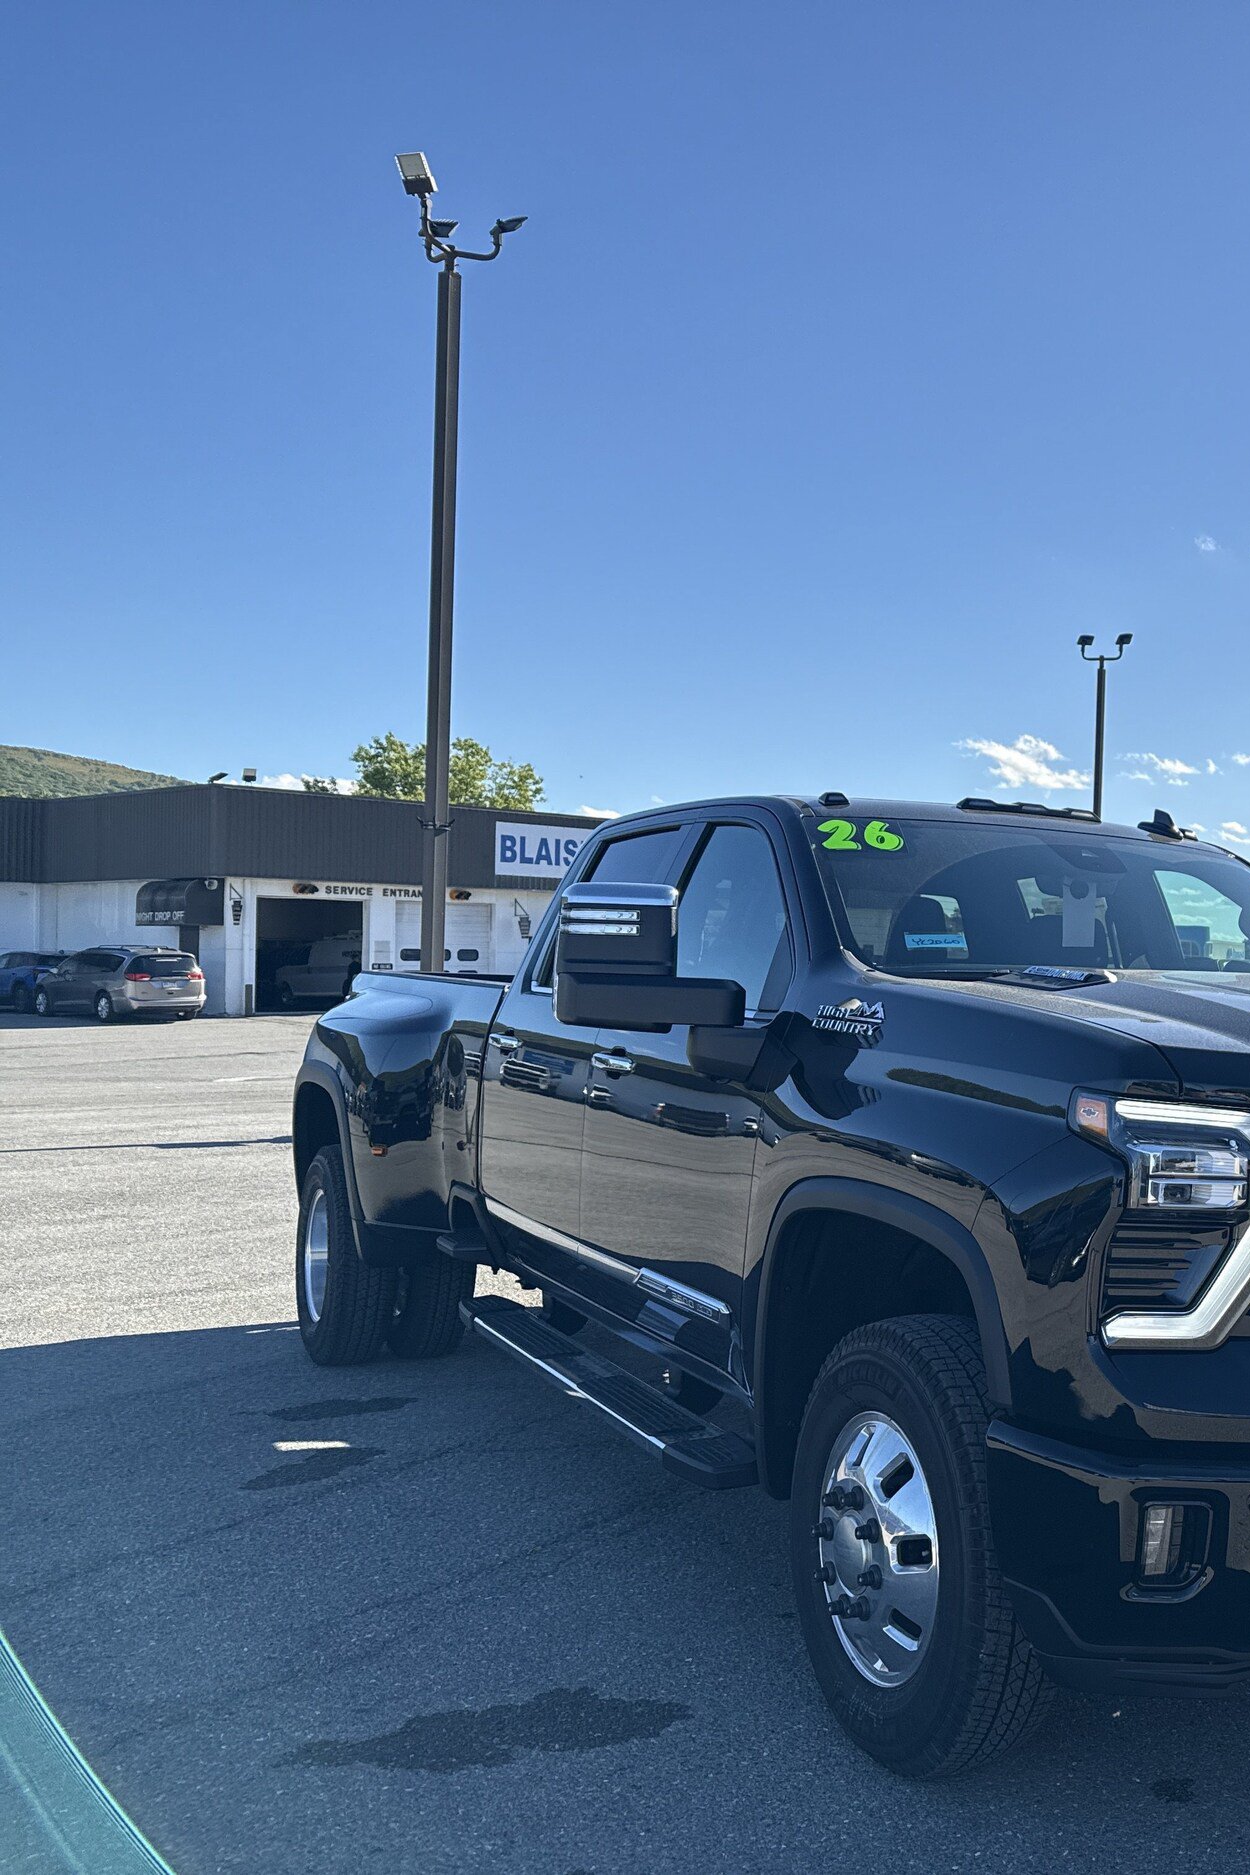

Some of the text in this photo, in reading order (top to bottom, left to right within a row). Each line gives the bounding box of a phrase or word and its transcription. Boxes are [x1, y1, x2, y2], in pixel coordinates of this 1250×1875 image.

[817, 819, 905, 851] 26
[500, 834, 584, 866] BLAIS
[325, 885, 423, 898] SERVICE ENTRAN
[136, 910, 185, 922] NIGHT DROP OFF
[817, 1004, 851, 1019] HIGH
[811, 1017, 878, 1036] COUNTRY
